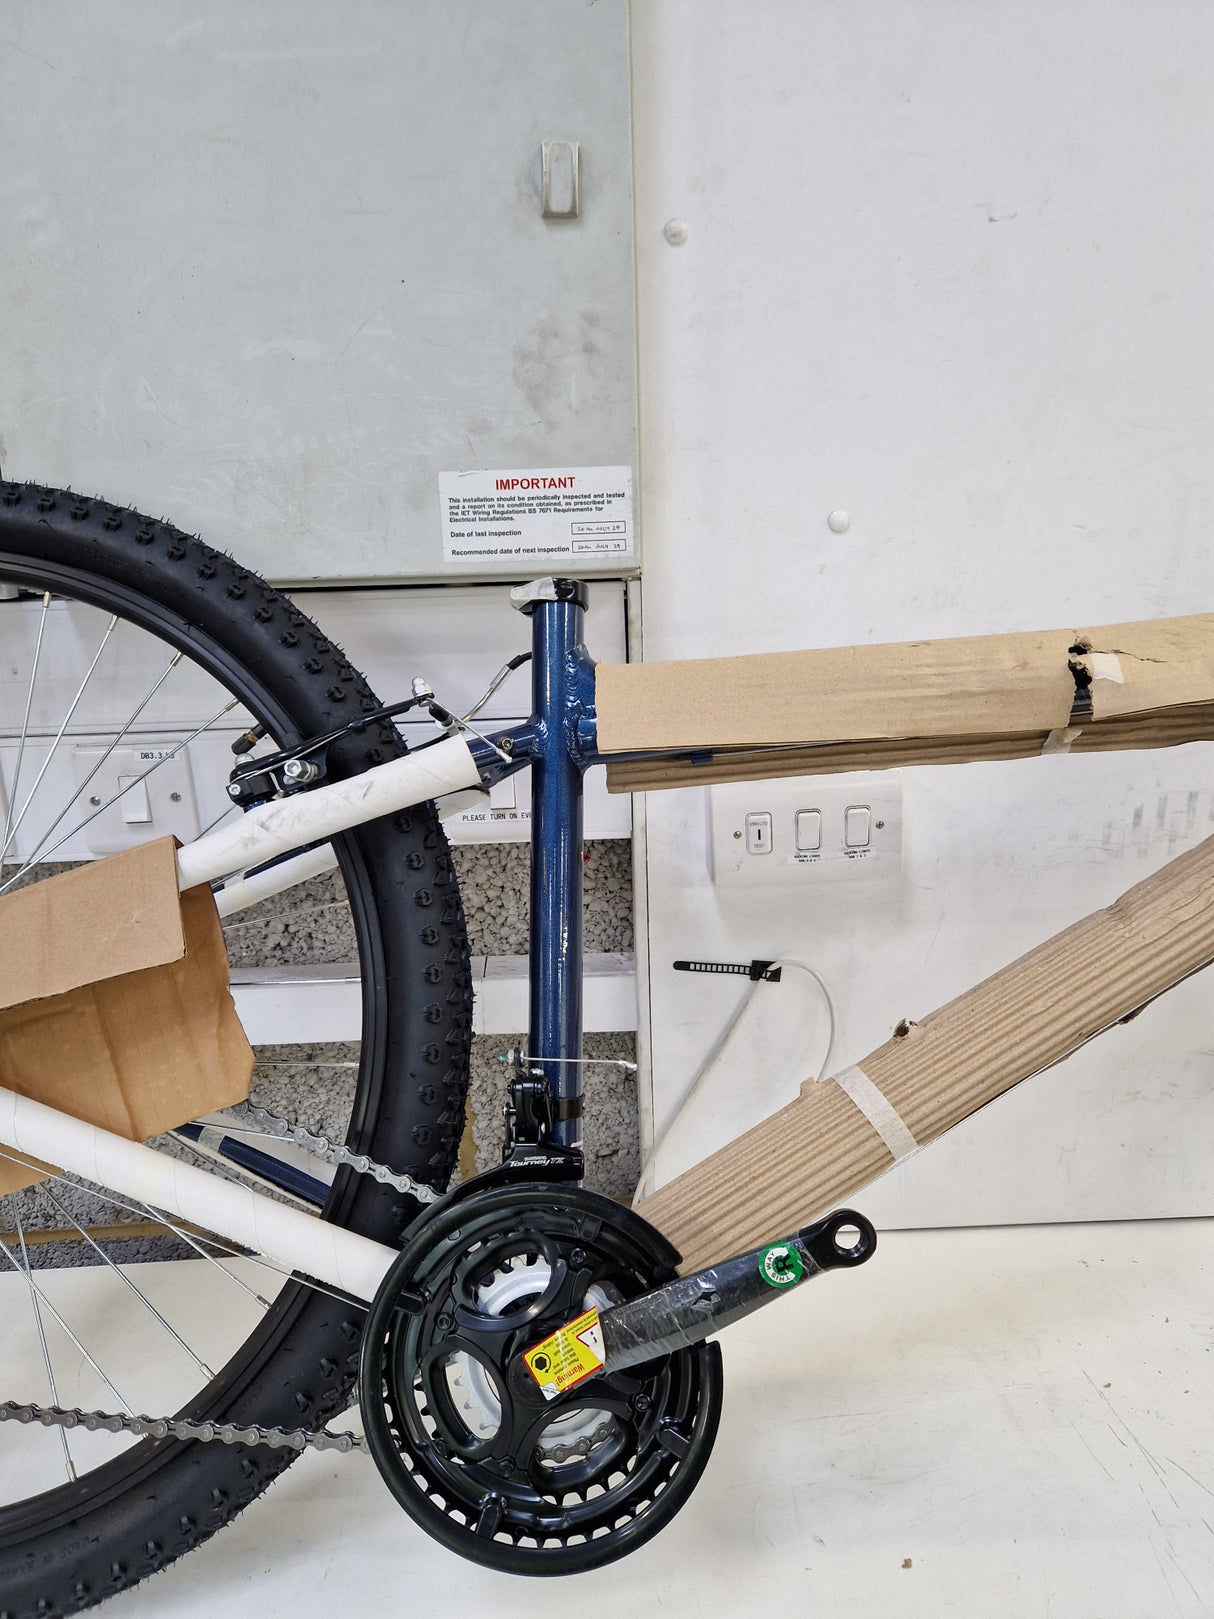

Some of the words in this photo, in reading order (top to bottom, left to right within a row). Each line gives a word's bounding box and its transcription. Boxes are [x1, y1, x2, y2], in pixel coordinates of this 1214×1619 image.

[495, 477, 576, 491] IMPORTANT
[527, 494, 561, 502] periodically
[562, 493, 592, 501] inspected
[467, 503, 486, 511] report
[573, 499, 605, 507] prescribed
[553, 506, 593, 514] Requirements
[488, 529, 522, 537] inspection
[451, 548, 499, 556] Recommended
[537, 546, 570, 554] inspection
[140, 751, 163, 759] DB3.3
[462, 814, 486, 822] PLEASE
[510, 1159, 550, 1167] Tourney
[766, 1251, 775, 1271] WAY
[775, 1253, 794, 1273] R
[771, 1272, 791, 1281] THIS
[555, 1363, 585, 1387] Warning!
